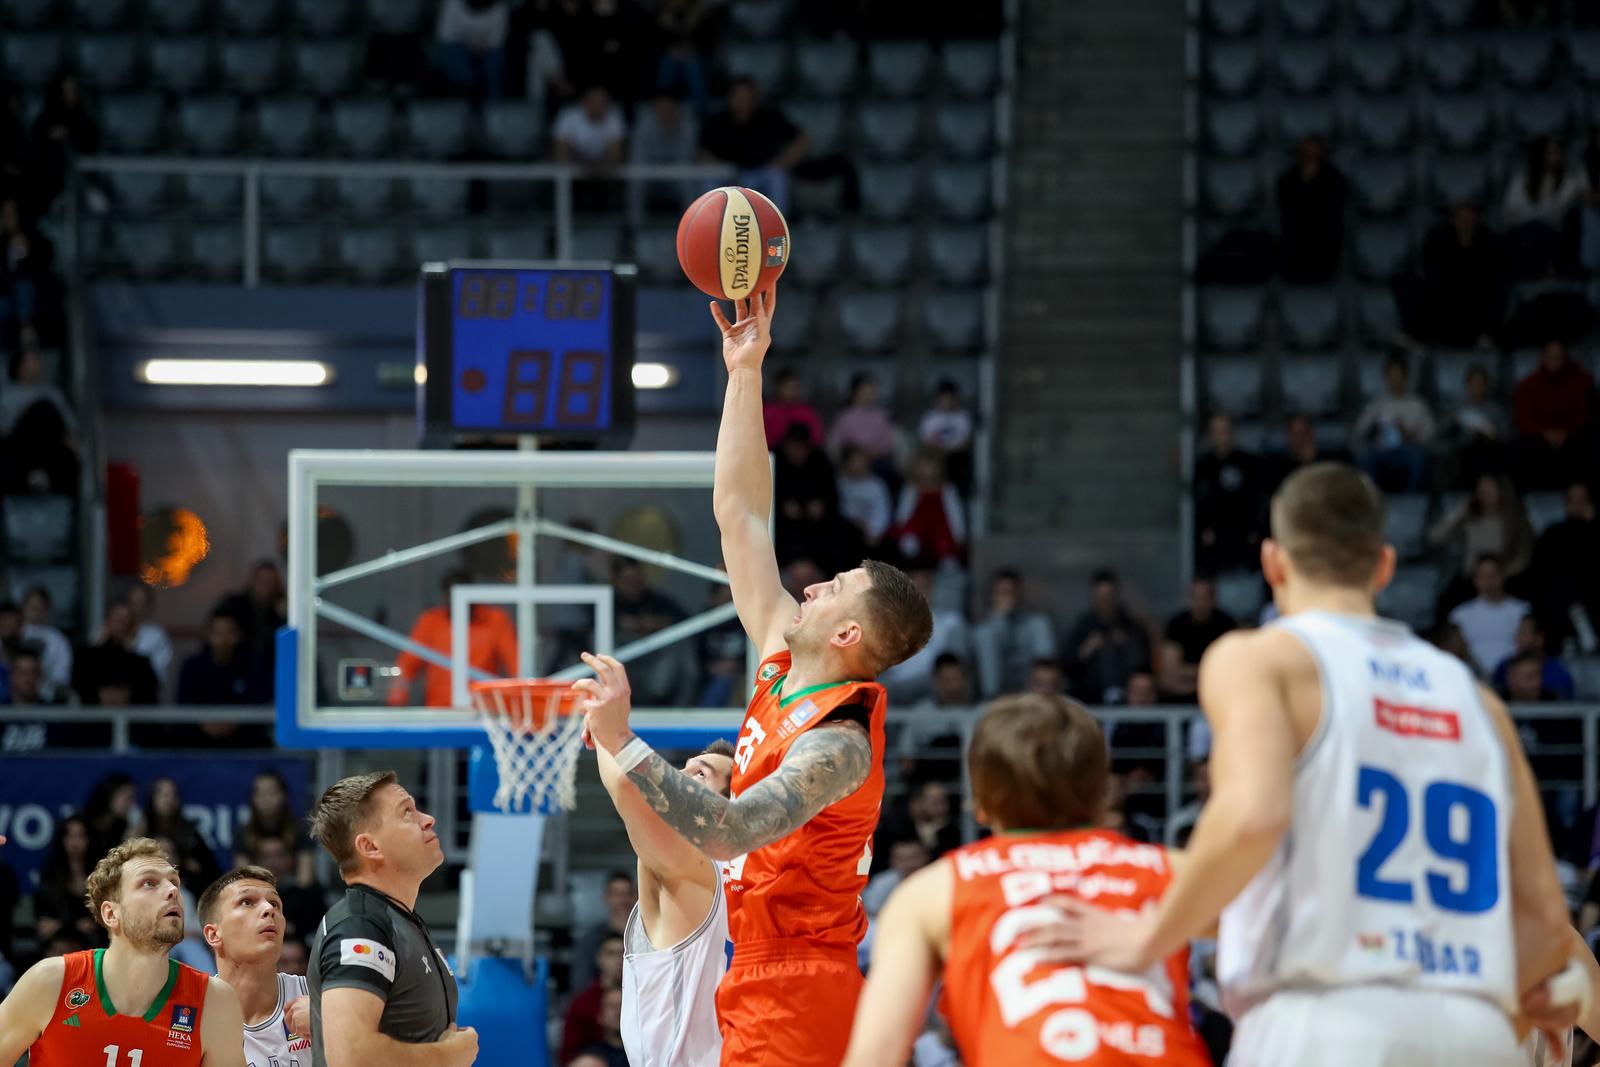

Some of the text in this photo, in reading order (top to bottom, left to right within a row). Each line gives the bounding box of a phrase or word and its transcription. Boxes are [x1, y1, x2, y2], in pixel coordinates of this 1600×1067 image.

[731, 214, 751, 290] SPALDING
[1355, 764, 1500, 916] 29
[103, 1044, 144, 1067] 11
[168, 1030, 192, 1042] HEKA
